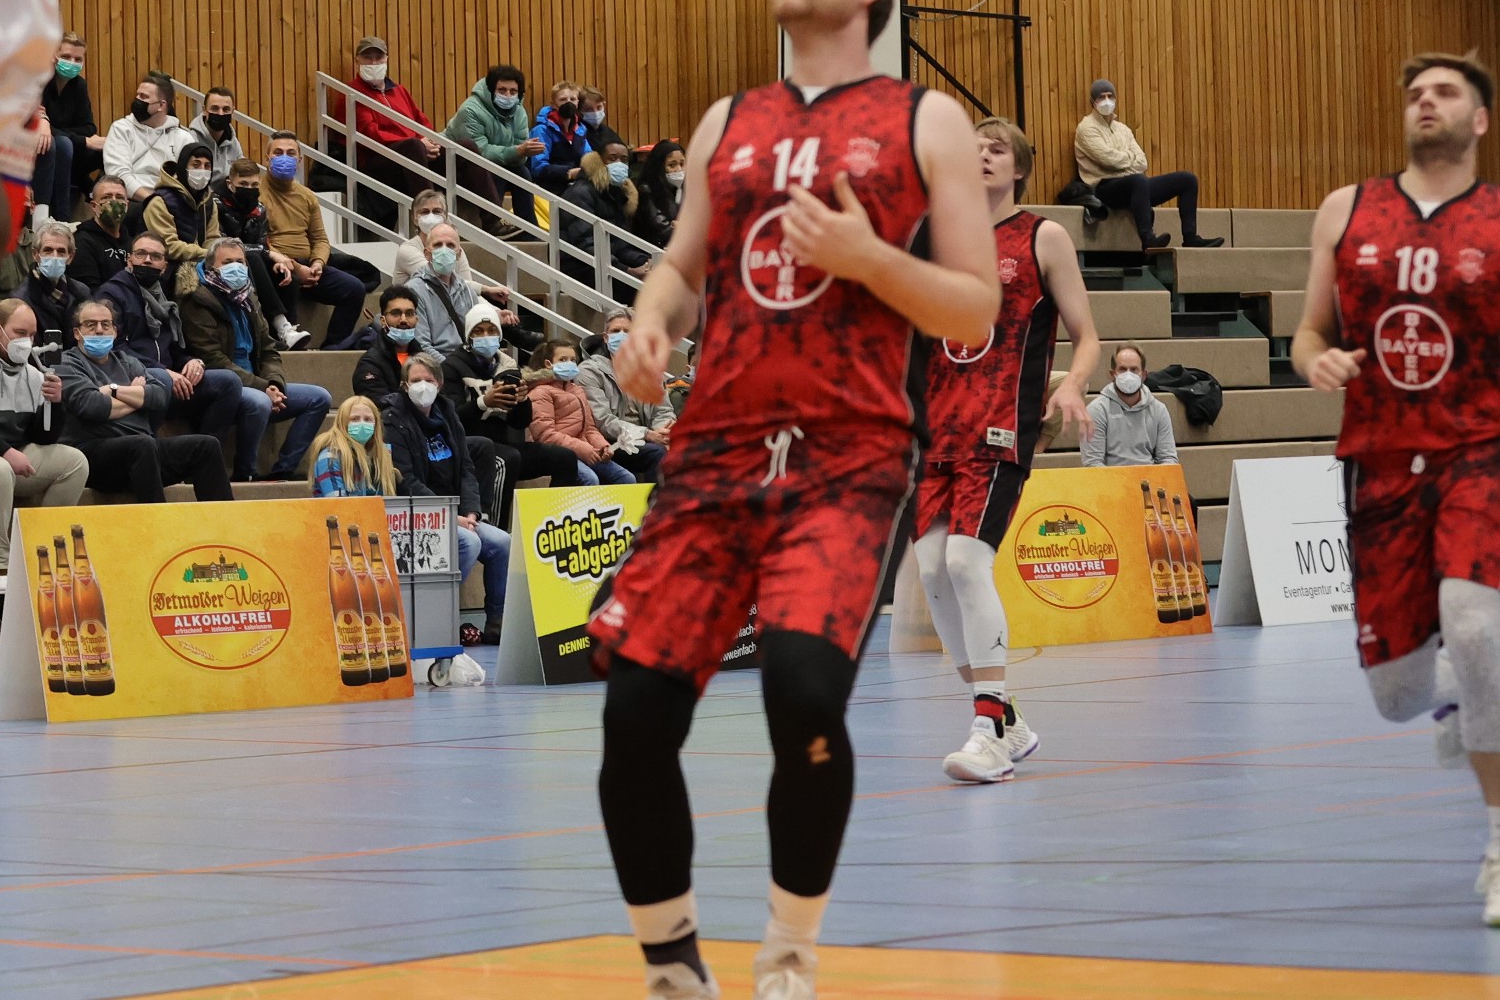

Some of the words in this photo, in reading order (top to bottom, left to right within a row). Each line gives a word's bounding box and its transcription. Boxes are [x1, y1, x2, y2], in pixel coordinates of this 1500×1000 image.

[772, 136, 821, 192] 14
[1395, 245, 1440, 294] 18
[1380, 338, 1447, 357] BAYER
[409, 513, 426, 530] ns
[538, 511, 602, 555] einfach
[1017, 543, 1069, 560] Detmolder
[1069, 537, 1115, 560] Weizen
[1033, 560, 1106, 574] ALKOHOLFREI
[153, 590, 224, 611] Detmolder
[224, 583, 286, 611] Weizen
[1283, 585, 1332, 599] Eventagentur
[174, 611, 272, 628] ALKOHOLFREI
[559, 636, 591, 656] DENNIS
